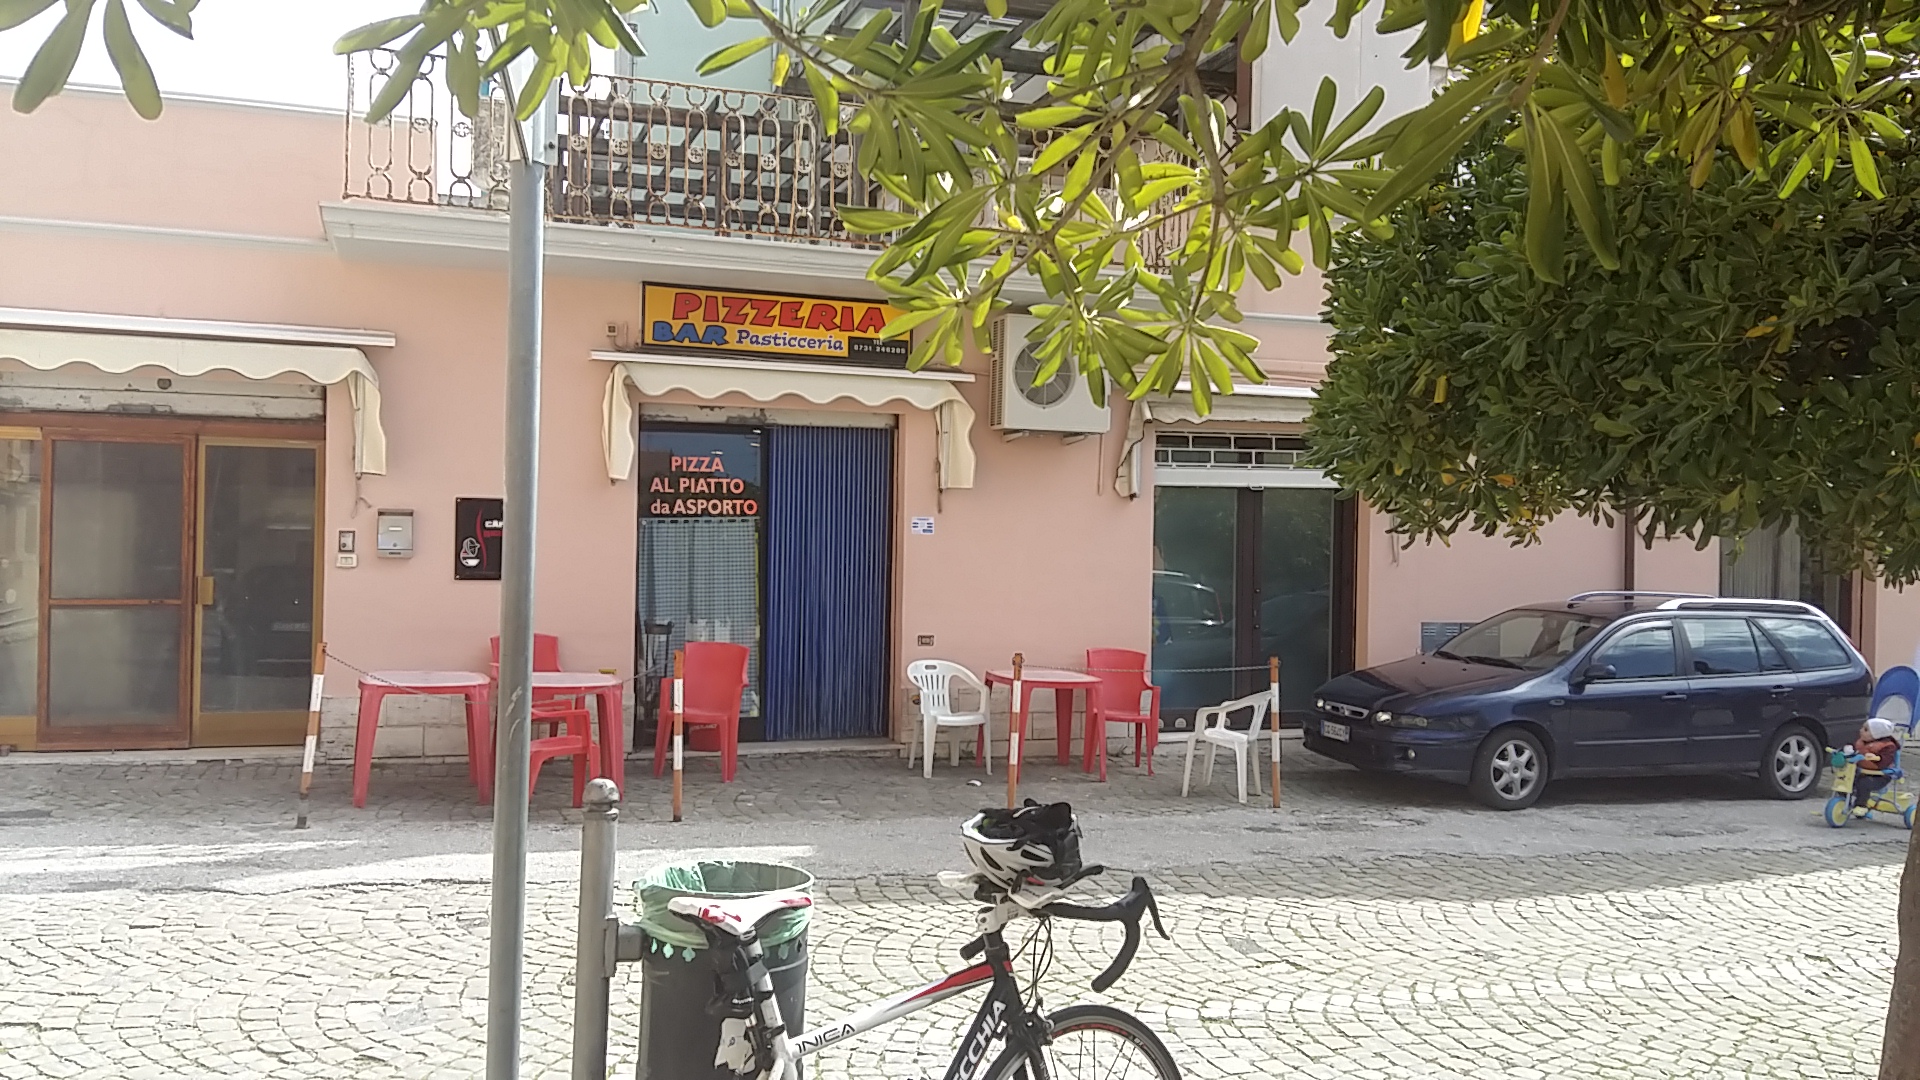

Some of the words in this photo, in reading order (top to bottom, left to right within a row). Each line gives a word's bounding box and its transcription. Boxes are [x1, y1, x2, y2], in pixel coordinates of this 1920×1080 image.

[672, 292, 887, 333] PIZZERIA
[652, 320, 729, 346] BAR
[736, 329, 844, 351] Pasticceria
[671, 456, 725, 473] PIZZA
[650, 477, 675, 493] AL
[680, 478, 745, 494] PIATTO
[650, 499, 670, 514] da
[672, 499, 758, 515] ASPORTO
